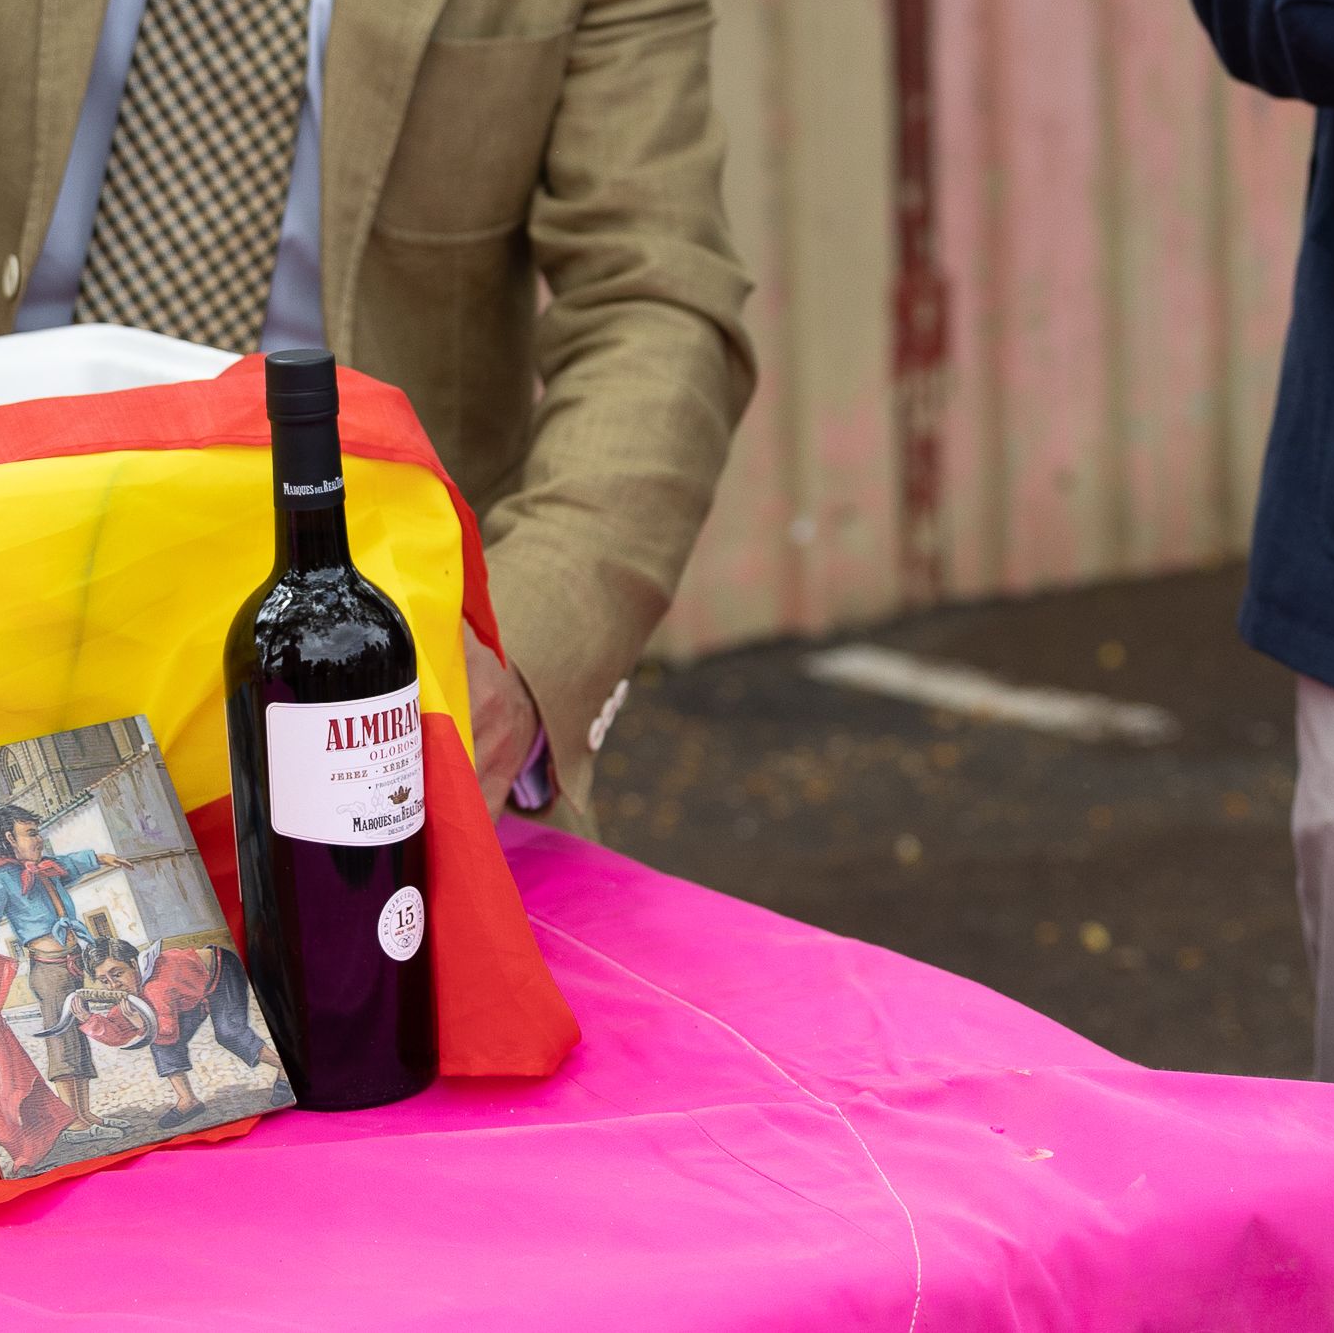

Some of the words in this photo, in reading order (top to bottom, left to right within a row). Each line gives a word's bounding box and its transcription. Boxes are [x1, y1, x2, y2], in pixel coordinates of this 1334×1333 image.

[326, 696, 421, 751] ALMIRAN
[370, 736, 419, 761] OLOROSO
[331, 769, 369, 781] JEREZ
[395, 904, 415, 930] 15
